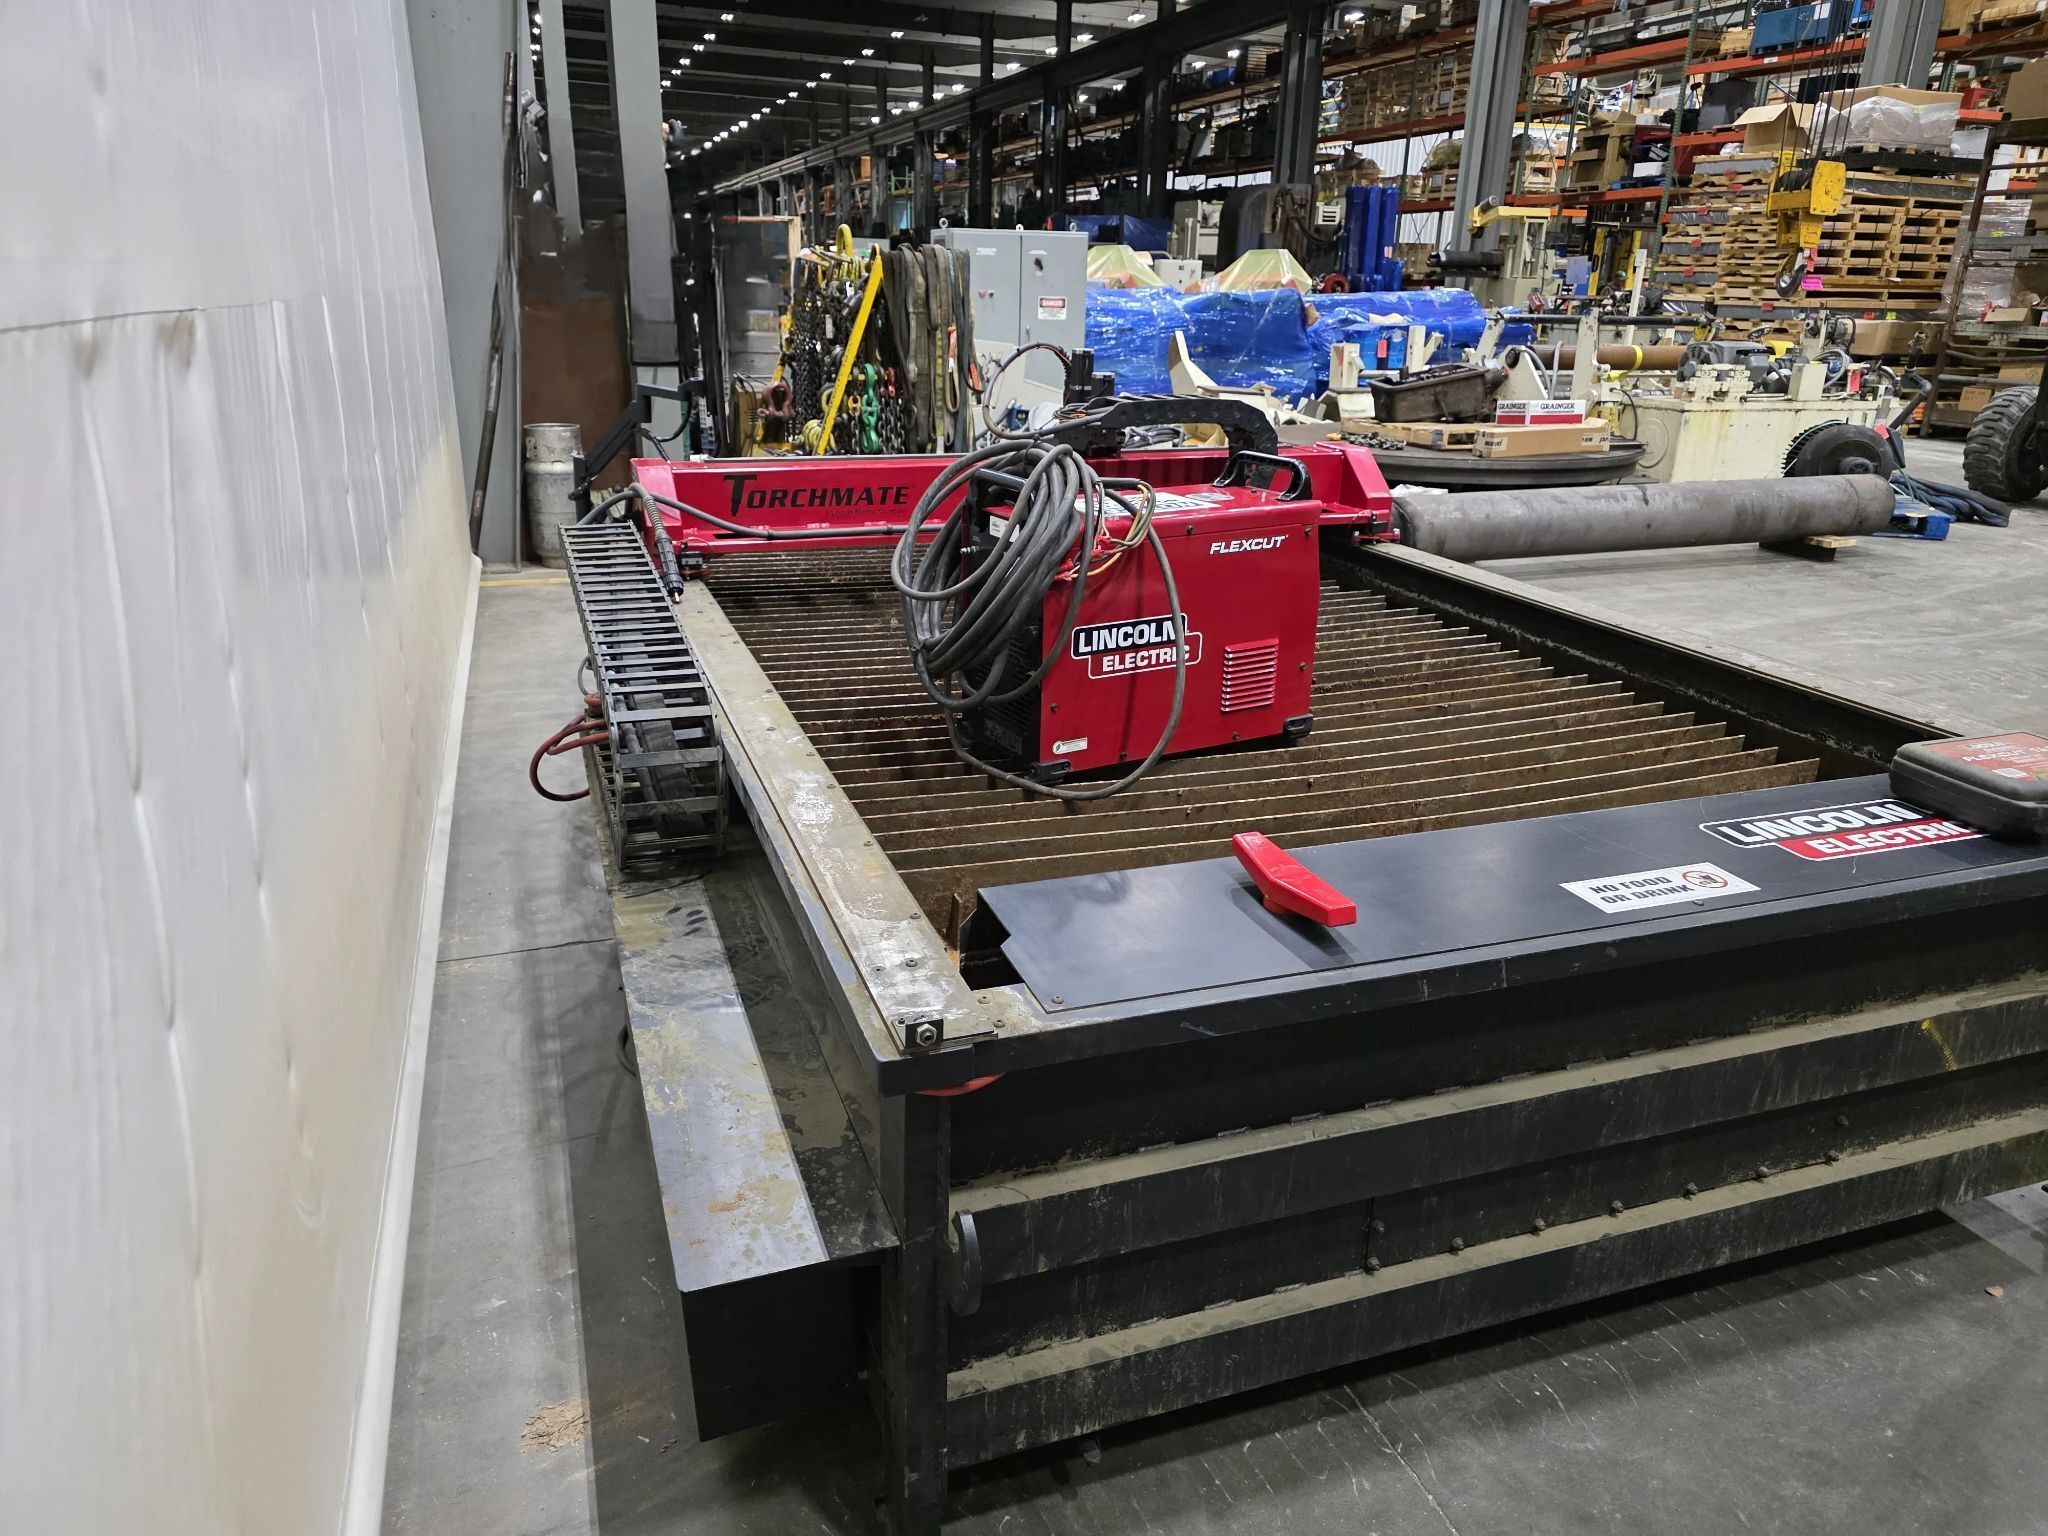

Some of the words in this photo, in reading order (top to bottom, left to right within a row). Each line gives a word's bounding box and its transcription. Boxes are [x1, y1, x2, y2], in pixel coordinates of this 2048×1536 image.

[1498, 402, 1526, 410] GRAINGER
[1541, 402, 1575, 410] GRAINGER
[723, 474, 909, 517] TORCHMATE
[1209, 535, 1286, 555] FLEXCUT
[1718, 803, 1924, 843] LINCOLN
[1589, 883, 1619, 894] NO
[1619, 876, 1674, 889] FOOD
[1600, 894, 1631, 904] OR
[1630, 884, 1695, 900] DRINK
